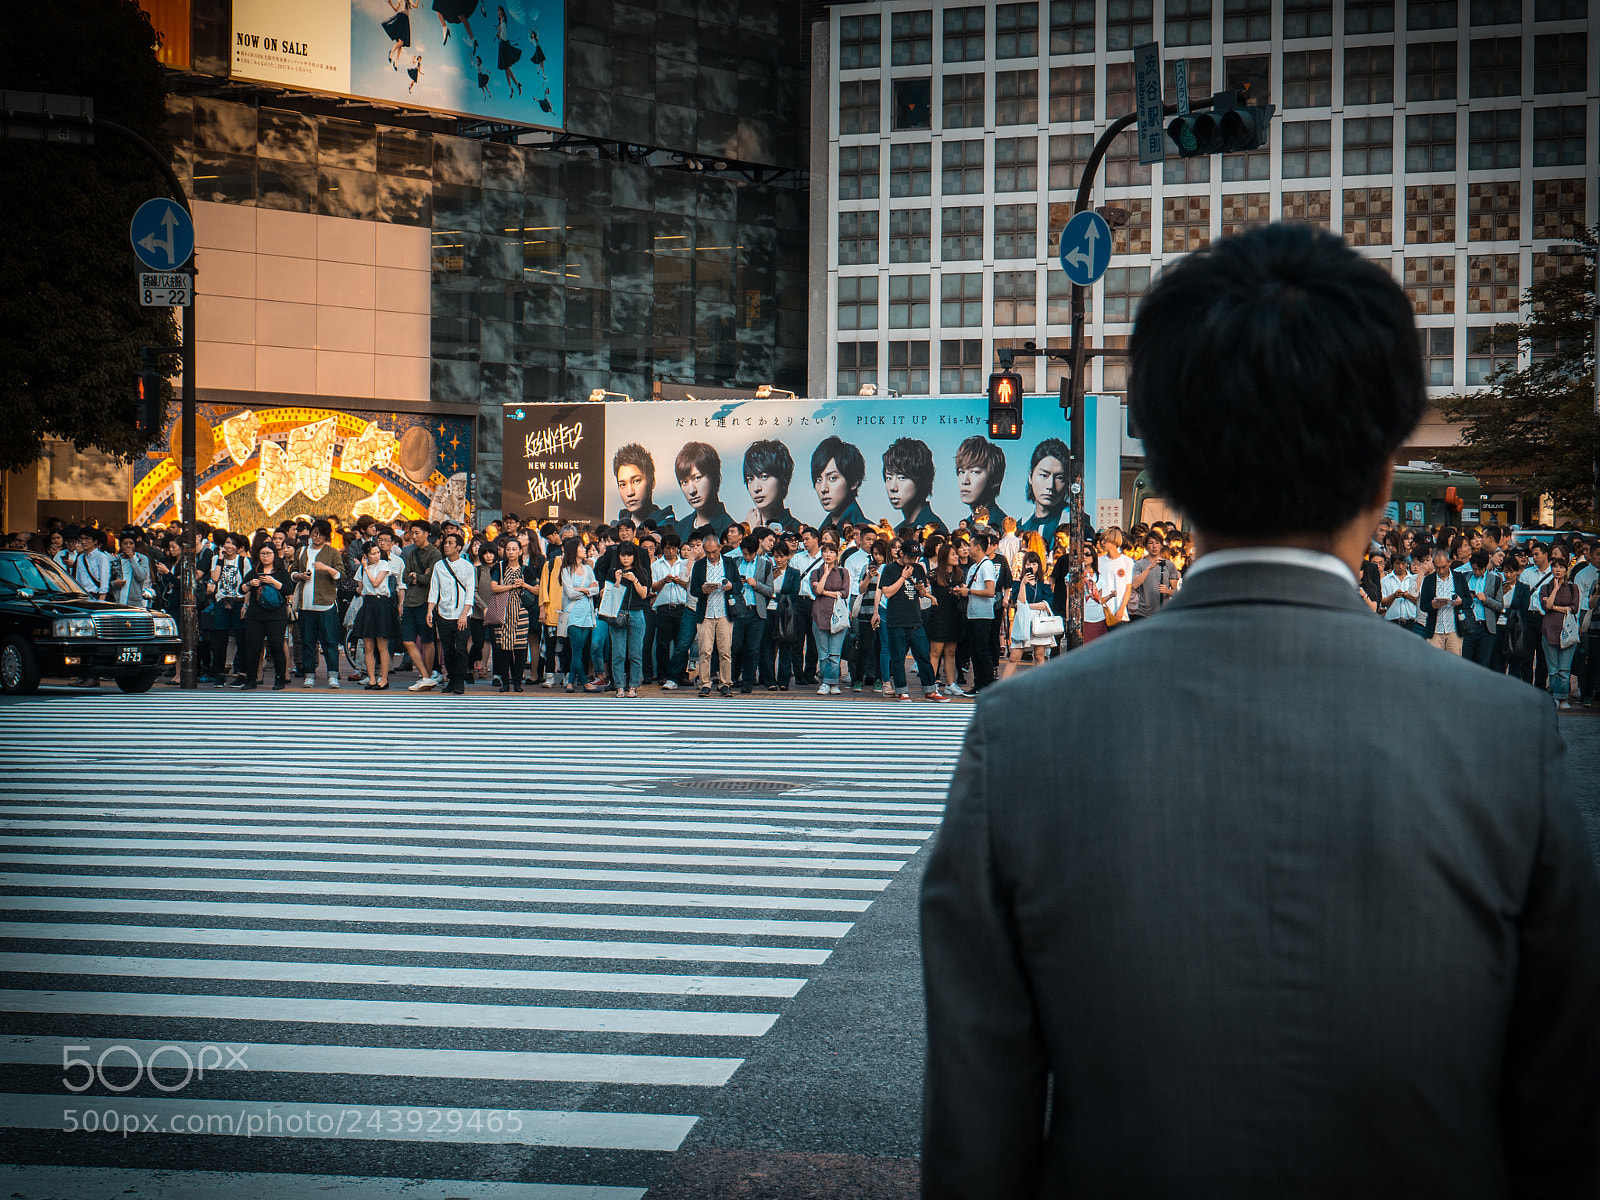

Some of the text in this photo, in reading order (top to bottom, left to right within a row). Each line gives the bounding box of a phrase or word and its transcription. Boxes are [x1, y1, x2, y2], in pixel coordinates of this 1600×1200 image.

[236, 32, 308, 57] NOW ON SALE
[1145, 53, 1161, 154] 渋谷駅前
[1176, 65, 1187, 114] スクラン
[1138, 71, 1148, 144] Shibuya Sta.
[142, 274, 187, 288] 路線バスを除く
[856, 415, 989, 425] PICK IT UP Kis-My-
[528, 461, 579, 470] NEW SINGLE
[524, 472, 582, 506] PICK IT UP
